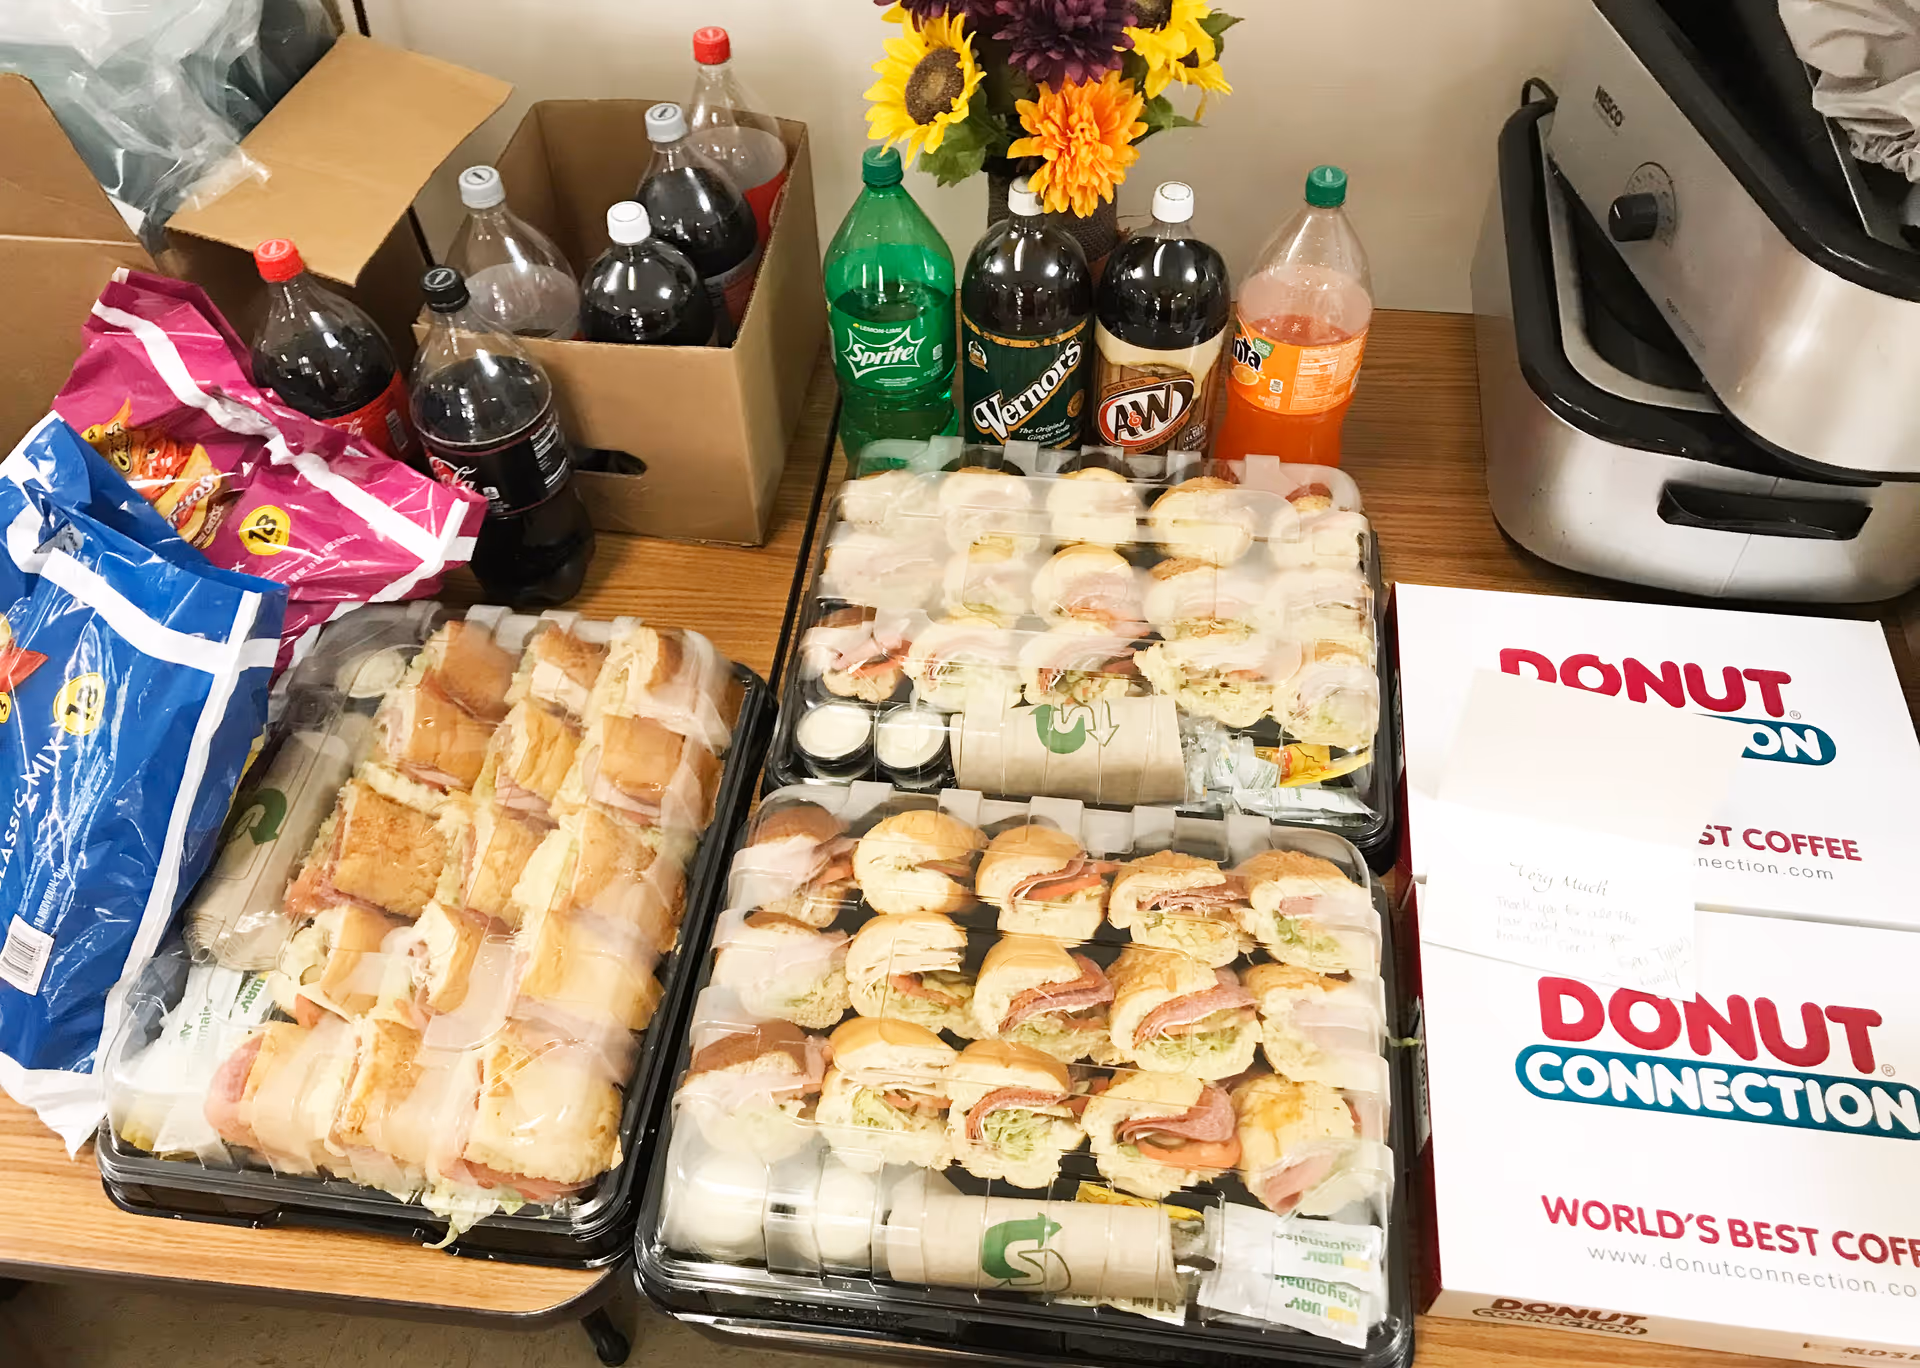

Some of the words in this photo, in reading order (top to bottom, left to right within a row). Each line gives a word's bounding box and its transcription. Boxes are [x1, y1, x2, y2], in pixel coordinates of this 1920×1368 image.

[1594, 84, 1624, 128] NESCO
[859, 324, 903, 335] LEMON-LIME
[849, 343, 915, 367] Sprite
[1232, 336, 1262, 371] nta
[972, 339, 1082, 440] Vernors
[1018, 427, 1034, 435] The
[1034, 418, 1068, 434] Original
[1113, 383, 1175, 443] A&W
[1027, 430, 1054, 441] Ginger
[248, 513, 278, 544] 18
[1500, 648, 1792, 718] DONUT
[1746, 722, 1823, 761] ON
[1742, 828, 1863, 862] COFFEE
[1698, 857, 1834, 880] nection.com
[36, 877, 60, 918] INDIVIDUAL
[1562, 875, 1608, 897] Much
[1537, 976, 1883, 1074] DONUT
[1525, 1050, 1920, 1134] CONNECTION
[1541, 1195, 1720, 1245] WORLD'S
[1727, 1217, 1819, 1256] BEST
[1476, 1308, 1641, 1335] CONNECTION
[1491, 1298, 1647, 1326] DONUT
